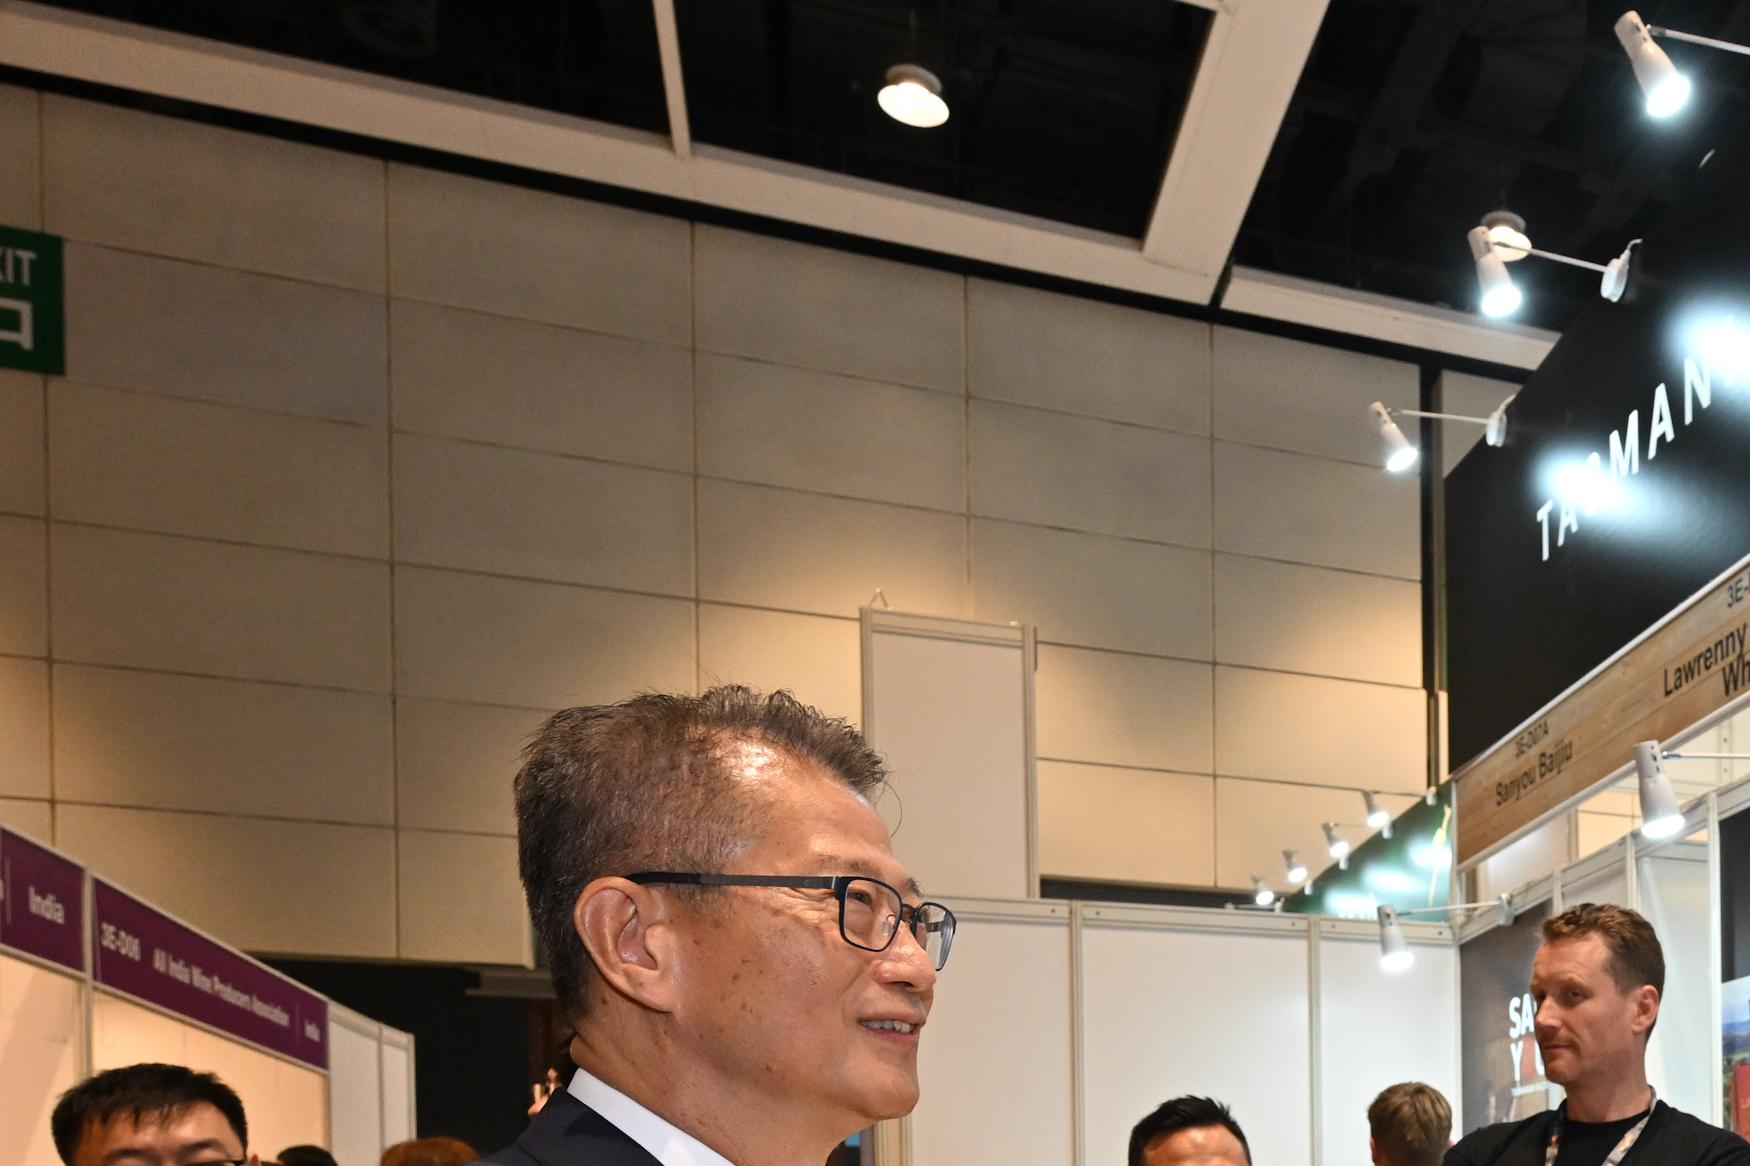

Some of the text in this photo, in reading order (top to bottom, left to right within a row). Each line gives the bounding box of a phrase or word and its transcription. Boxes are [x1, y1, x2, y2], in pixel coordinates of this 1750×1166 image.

[1664, 623, 1747, 697] Lawrenny
[28, 886, 65, 924] India
[1509, 993, 1538, 1039] SA
